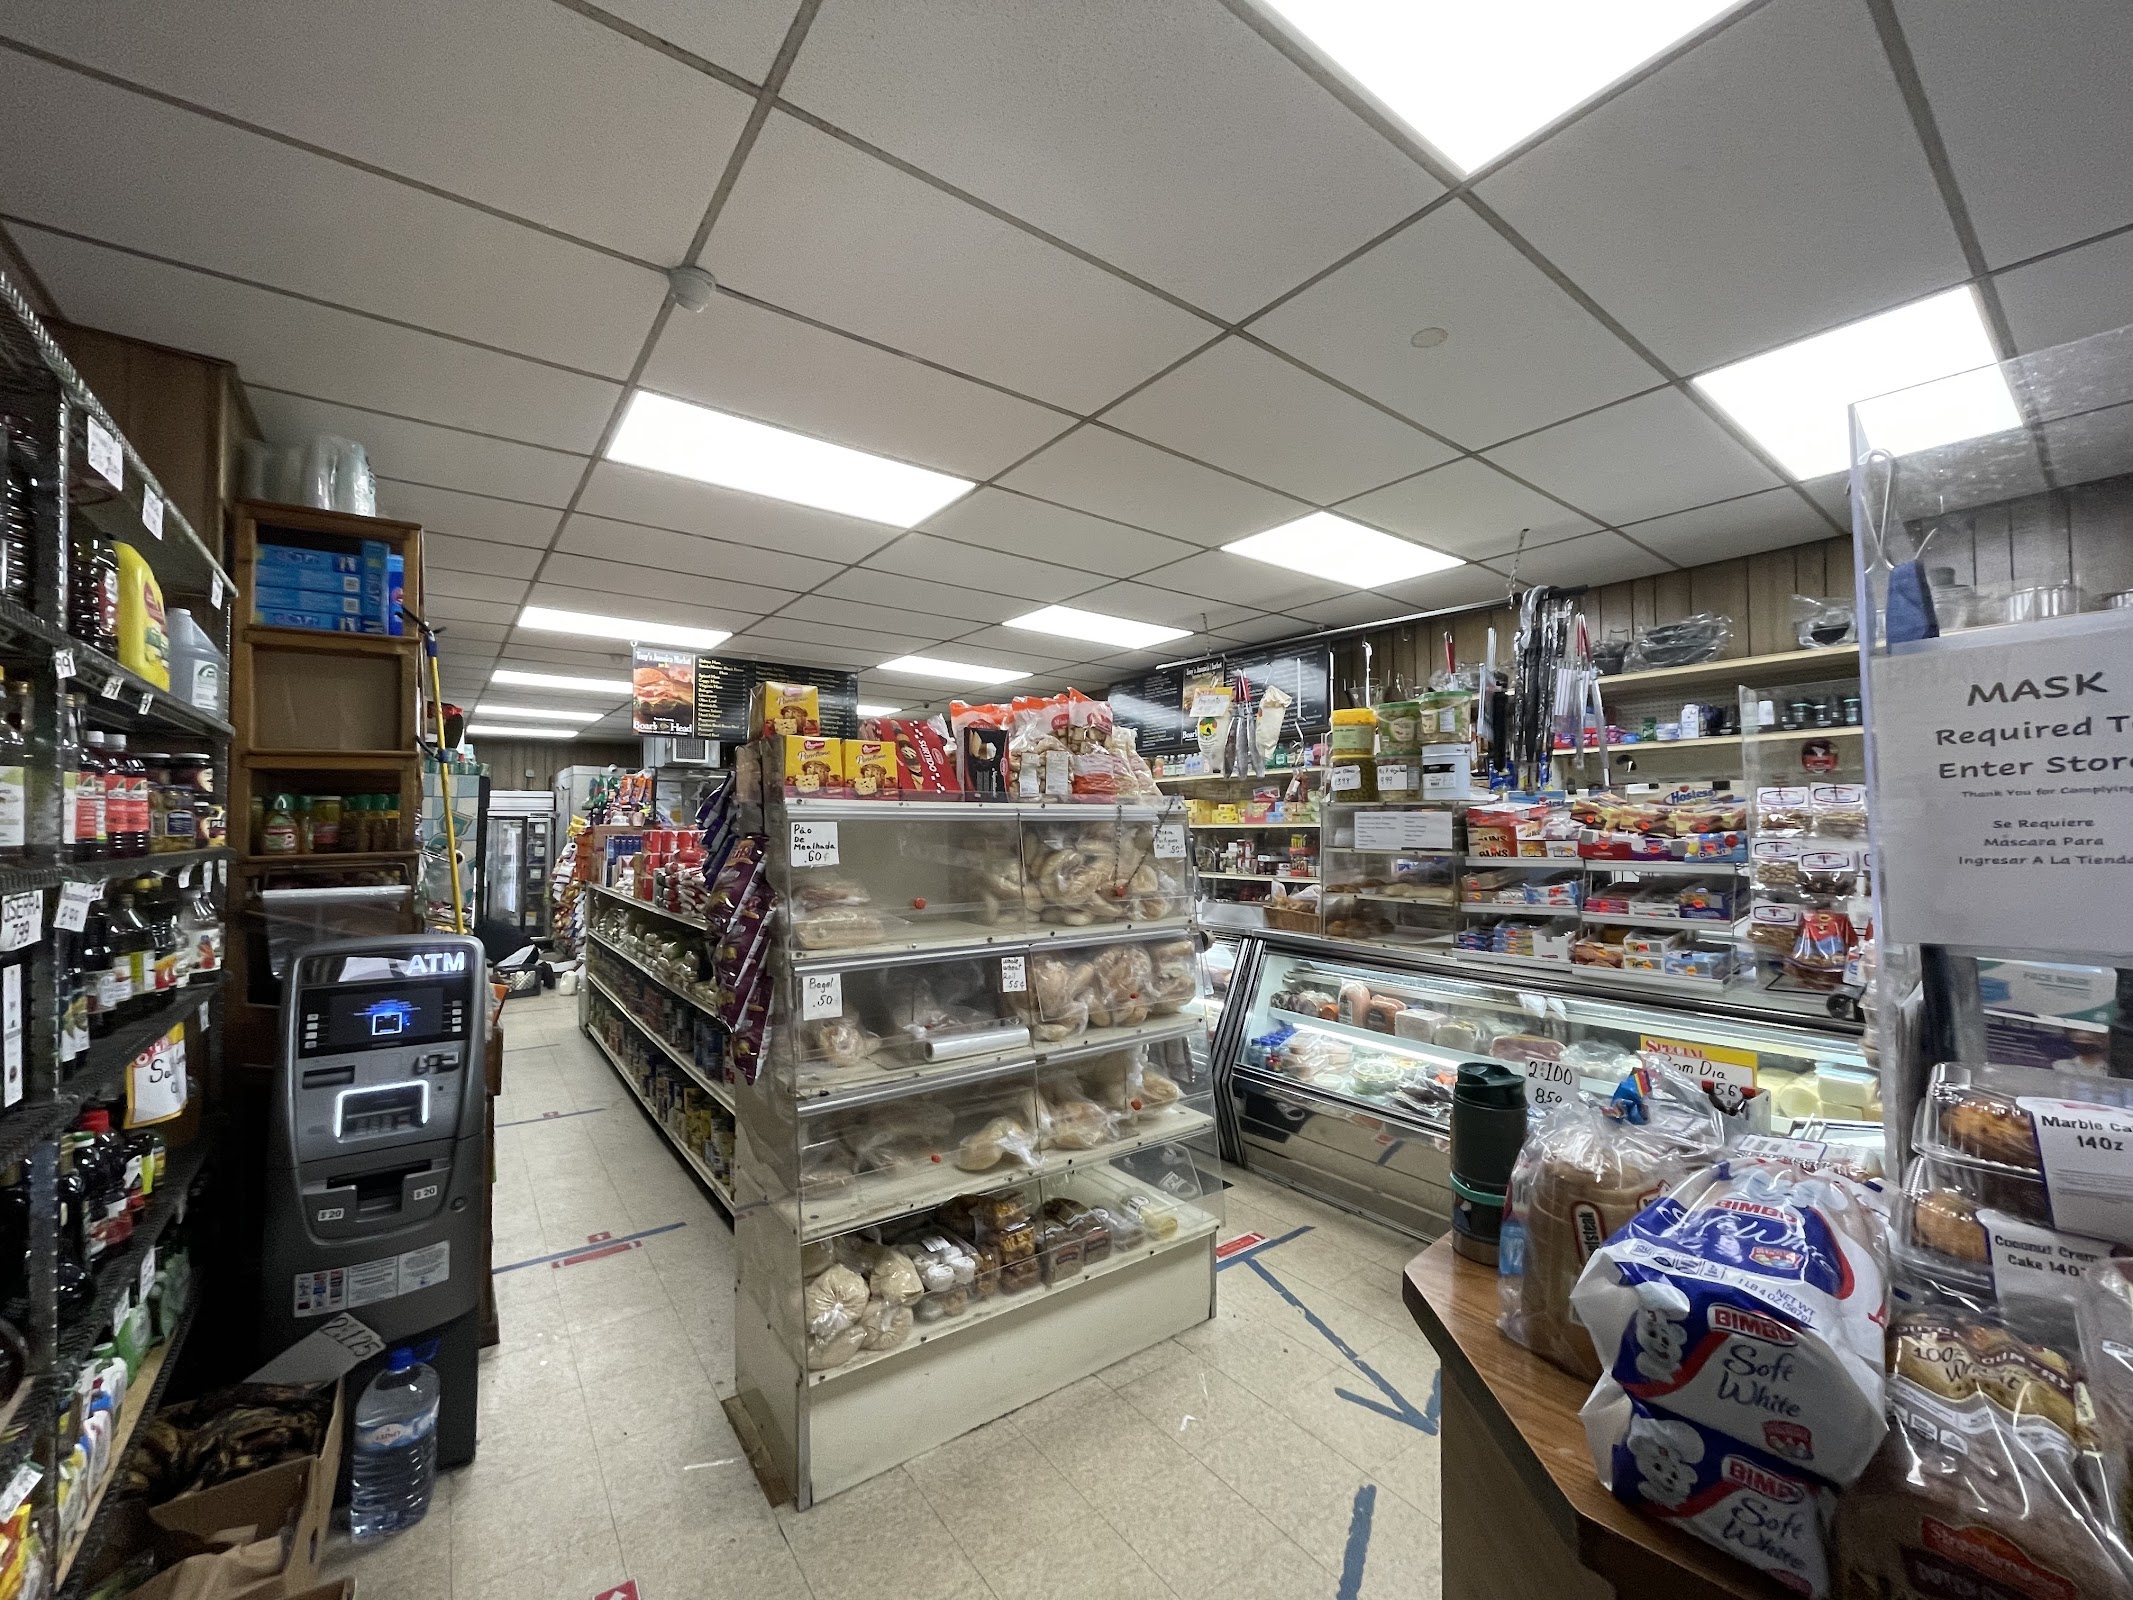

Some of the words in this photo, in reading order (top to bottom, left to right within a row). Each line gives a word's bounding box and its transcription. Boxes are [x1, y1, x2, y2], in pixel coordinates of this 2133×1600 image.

[1967, 671, 2109, 706] MASK
[633, 720, 657, 730] Boar's
[671, 723, 692, 732] Head
[1935, 716, 2093, 747] Required
[2106, 715, 2133, 733] T
[918, 740, 937, 772] SURTIDO
[1939, 761, 2034, 779] Enter
[1671, 789, 1716, 804] Hostess
[1962, 790, 2003, 798] Thank
[2036, 788, 2055, 796] for
[1993, 820, 2012, 829] Se
[2018, 818, 2095, 830] Requiere
[793, 841, 836, 851] Mealhada
[2063, 837, 2104, 846] Para
[1959, 855, 2026, 866] Ingresar
[2033, 855, 2043, 864] A
[2050, 856, 2070, 864] La
[406, 951, 465, 975] ATM
[809, 977, 834, 993] Bagel
[812, 994, 833, 1007] .50
[1645, 1040, 1703, 1058] SPECIAL
[1700, 1060, 1727, 1080] Dia
[2041, 1115, 2103, 1131] Marble
[2109, 1122, 2133, 1133] Ca
[423, 1187, 436, 1197] 20
[328, 1210, 342, 1219] 20
[1714, 1199, 1798, 1224] BIMBO
[1995, 1235, 2052, 1255] Coconut
[2008, 1254, 2043, 1271] Cake
[1744, 1281, 1760, 1293] LB
[1759, 1288, 1766, 1297] 4
[1767, 1292, 1782, 1306] OZ
[1776, 1289, 1797, 1304] NET
[1798, 1301, 1816, 1316] WT
[1714, 1309, 1794, 1343] BIMBO
[1723, 1344, 1796, 1383] Soft
[1718, 1371, 1802, 1418] White
[1731, 1497, 1804, 1540] Soft
[1723, 1518, 1807, 1570] White
